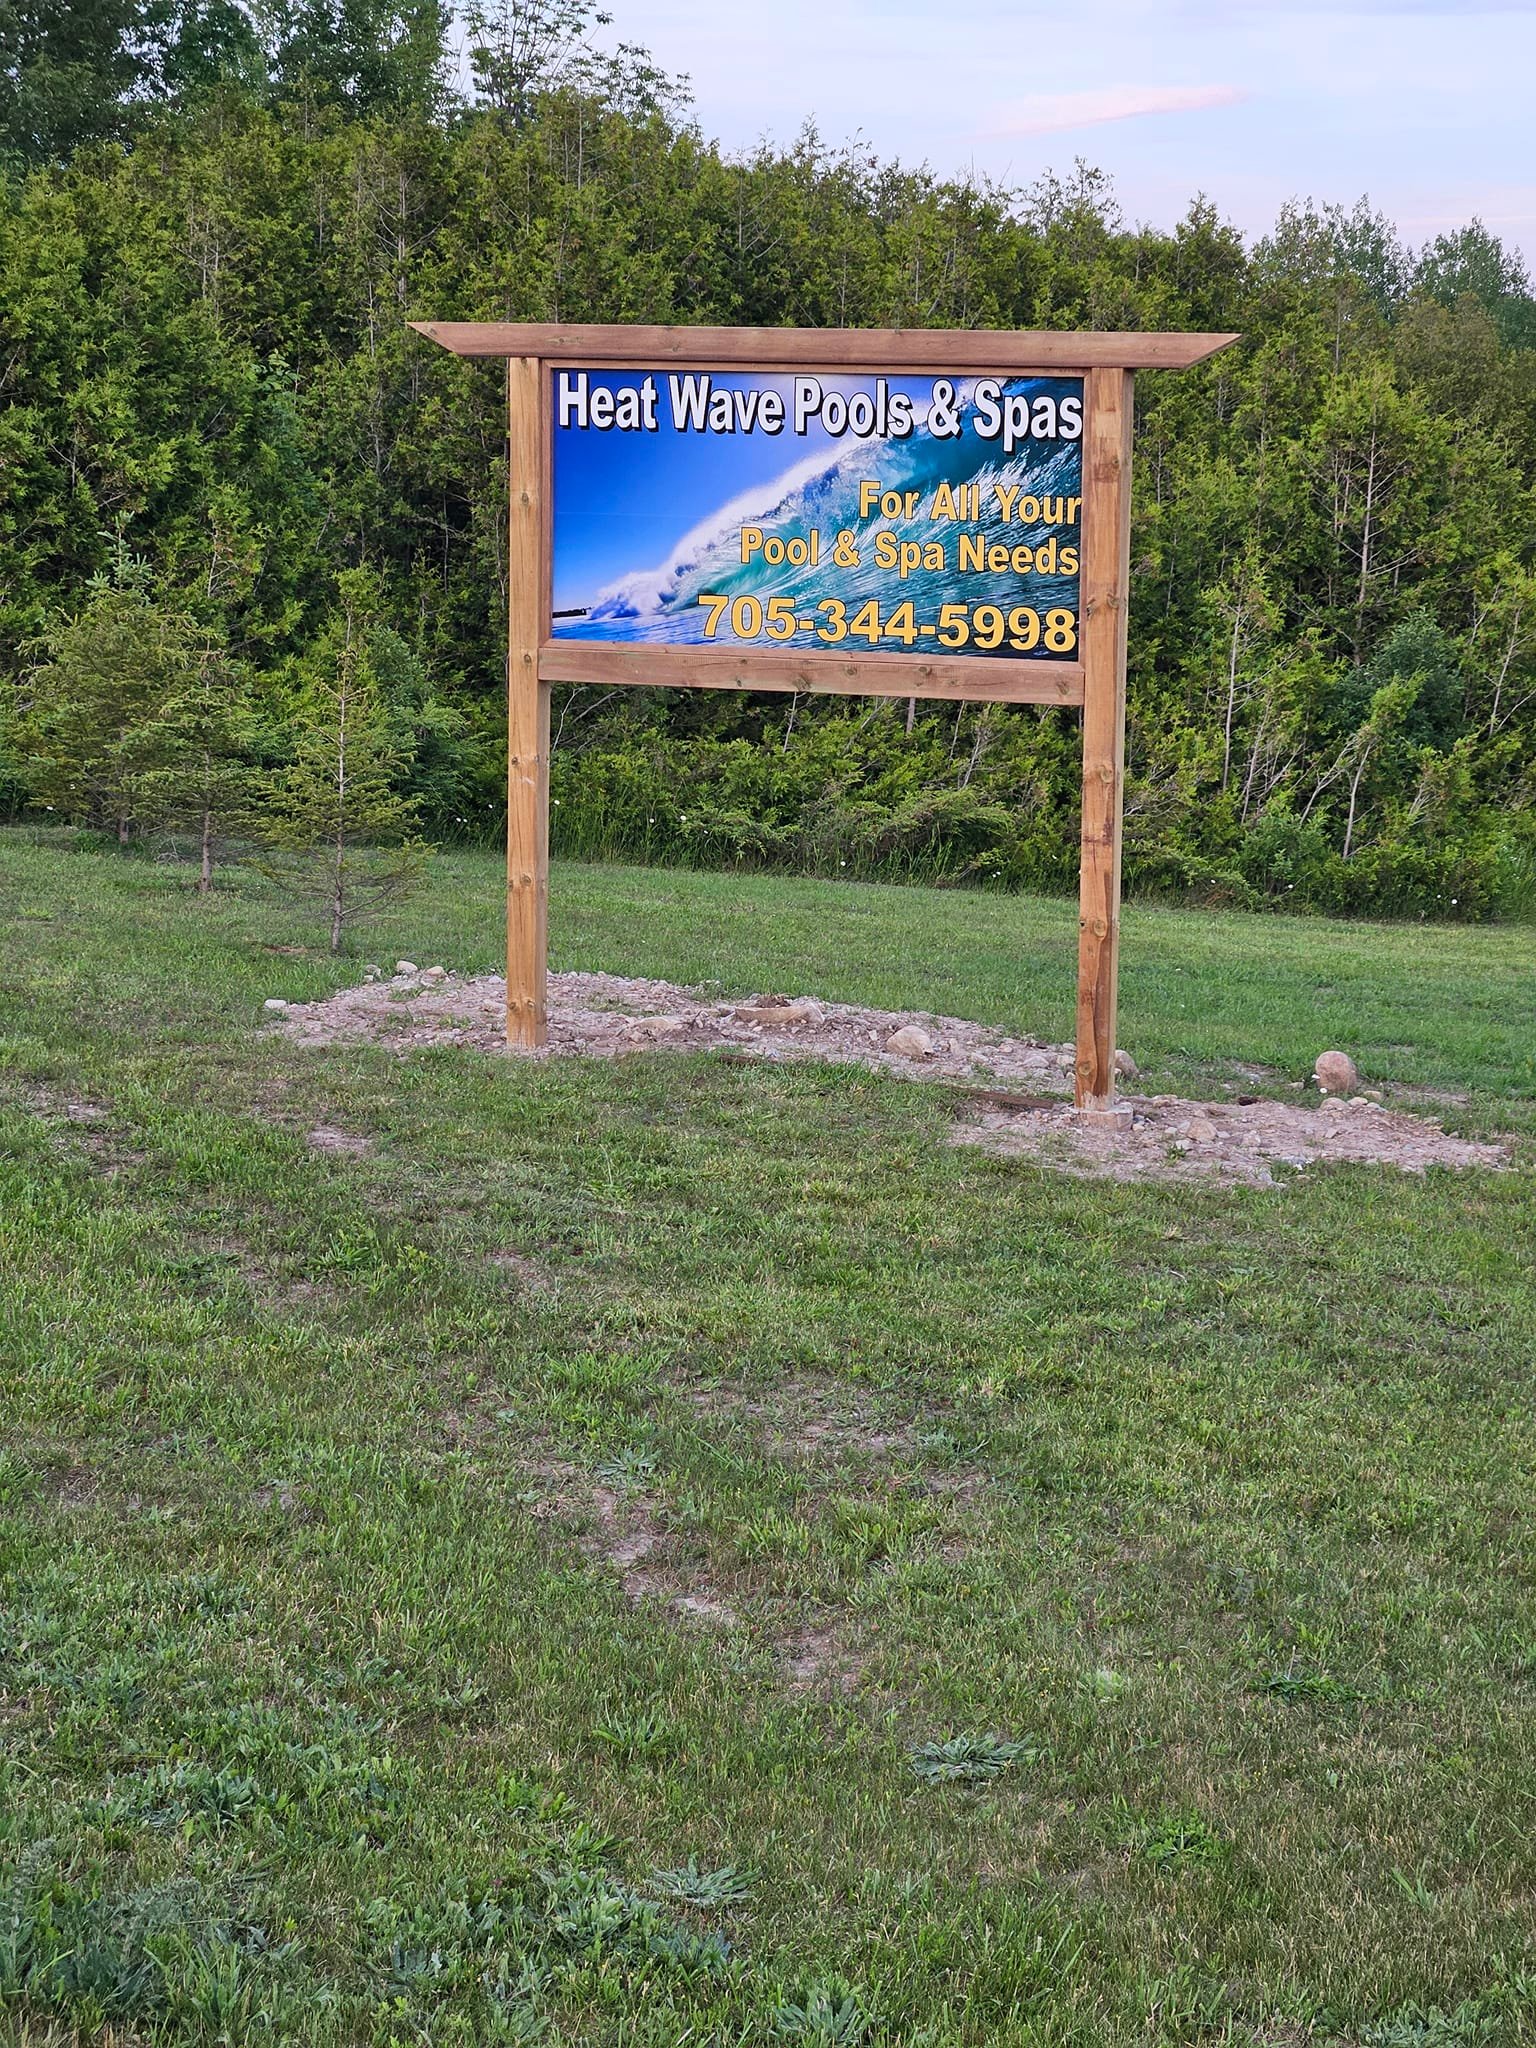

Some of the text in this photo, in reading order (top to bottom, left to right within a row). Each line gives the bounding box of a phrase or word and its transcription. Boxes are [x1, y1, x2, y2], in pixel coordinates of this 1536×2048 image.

[559, 372, 1083, 453] Heat Wave Pools & Spas
[859, 480, 1082, 524] For All Your
[740, 526, 1079, 578] Pool & Spa Needs
[698, 595, 1077, 653] 705-344-5998
